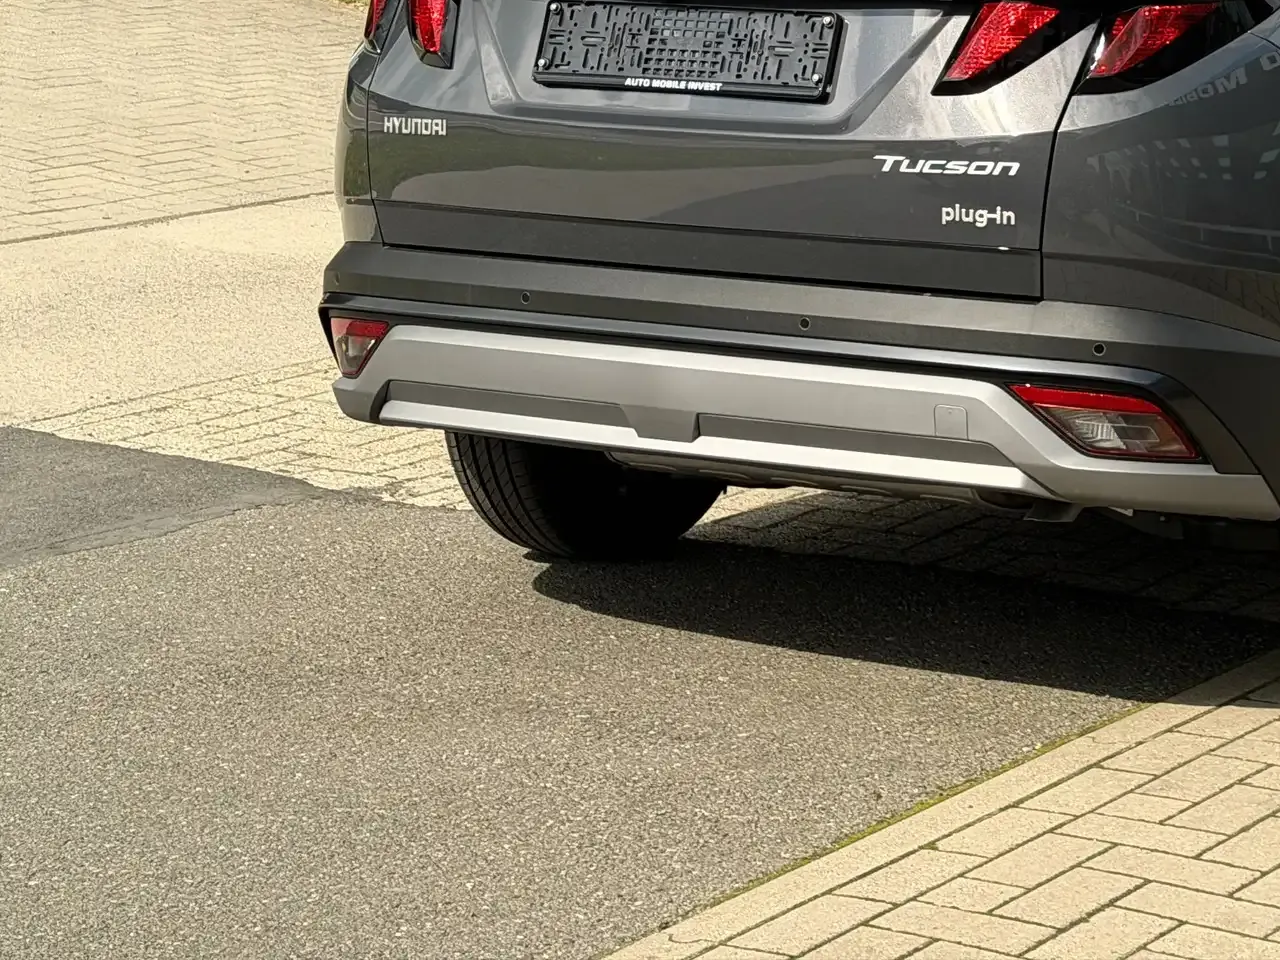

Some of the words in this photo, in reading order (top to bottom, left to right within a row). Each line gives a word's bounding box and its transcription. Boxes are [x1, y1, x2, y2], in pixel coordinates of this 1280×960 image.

[625, 77, 650, 88] AUTO
[651, 79, 687, 90] MOBILE
[687, 81, 723, 91] INVEST
[383, 116, 447, 136] HYUNDAI
[941, 203, 1016, 228] plug-in
